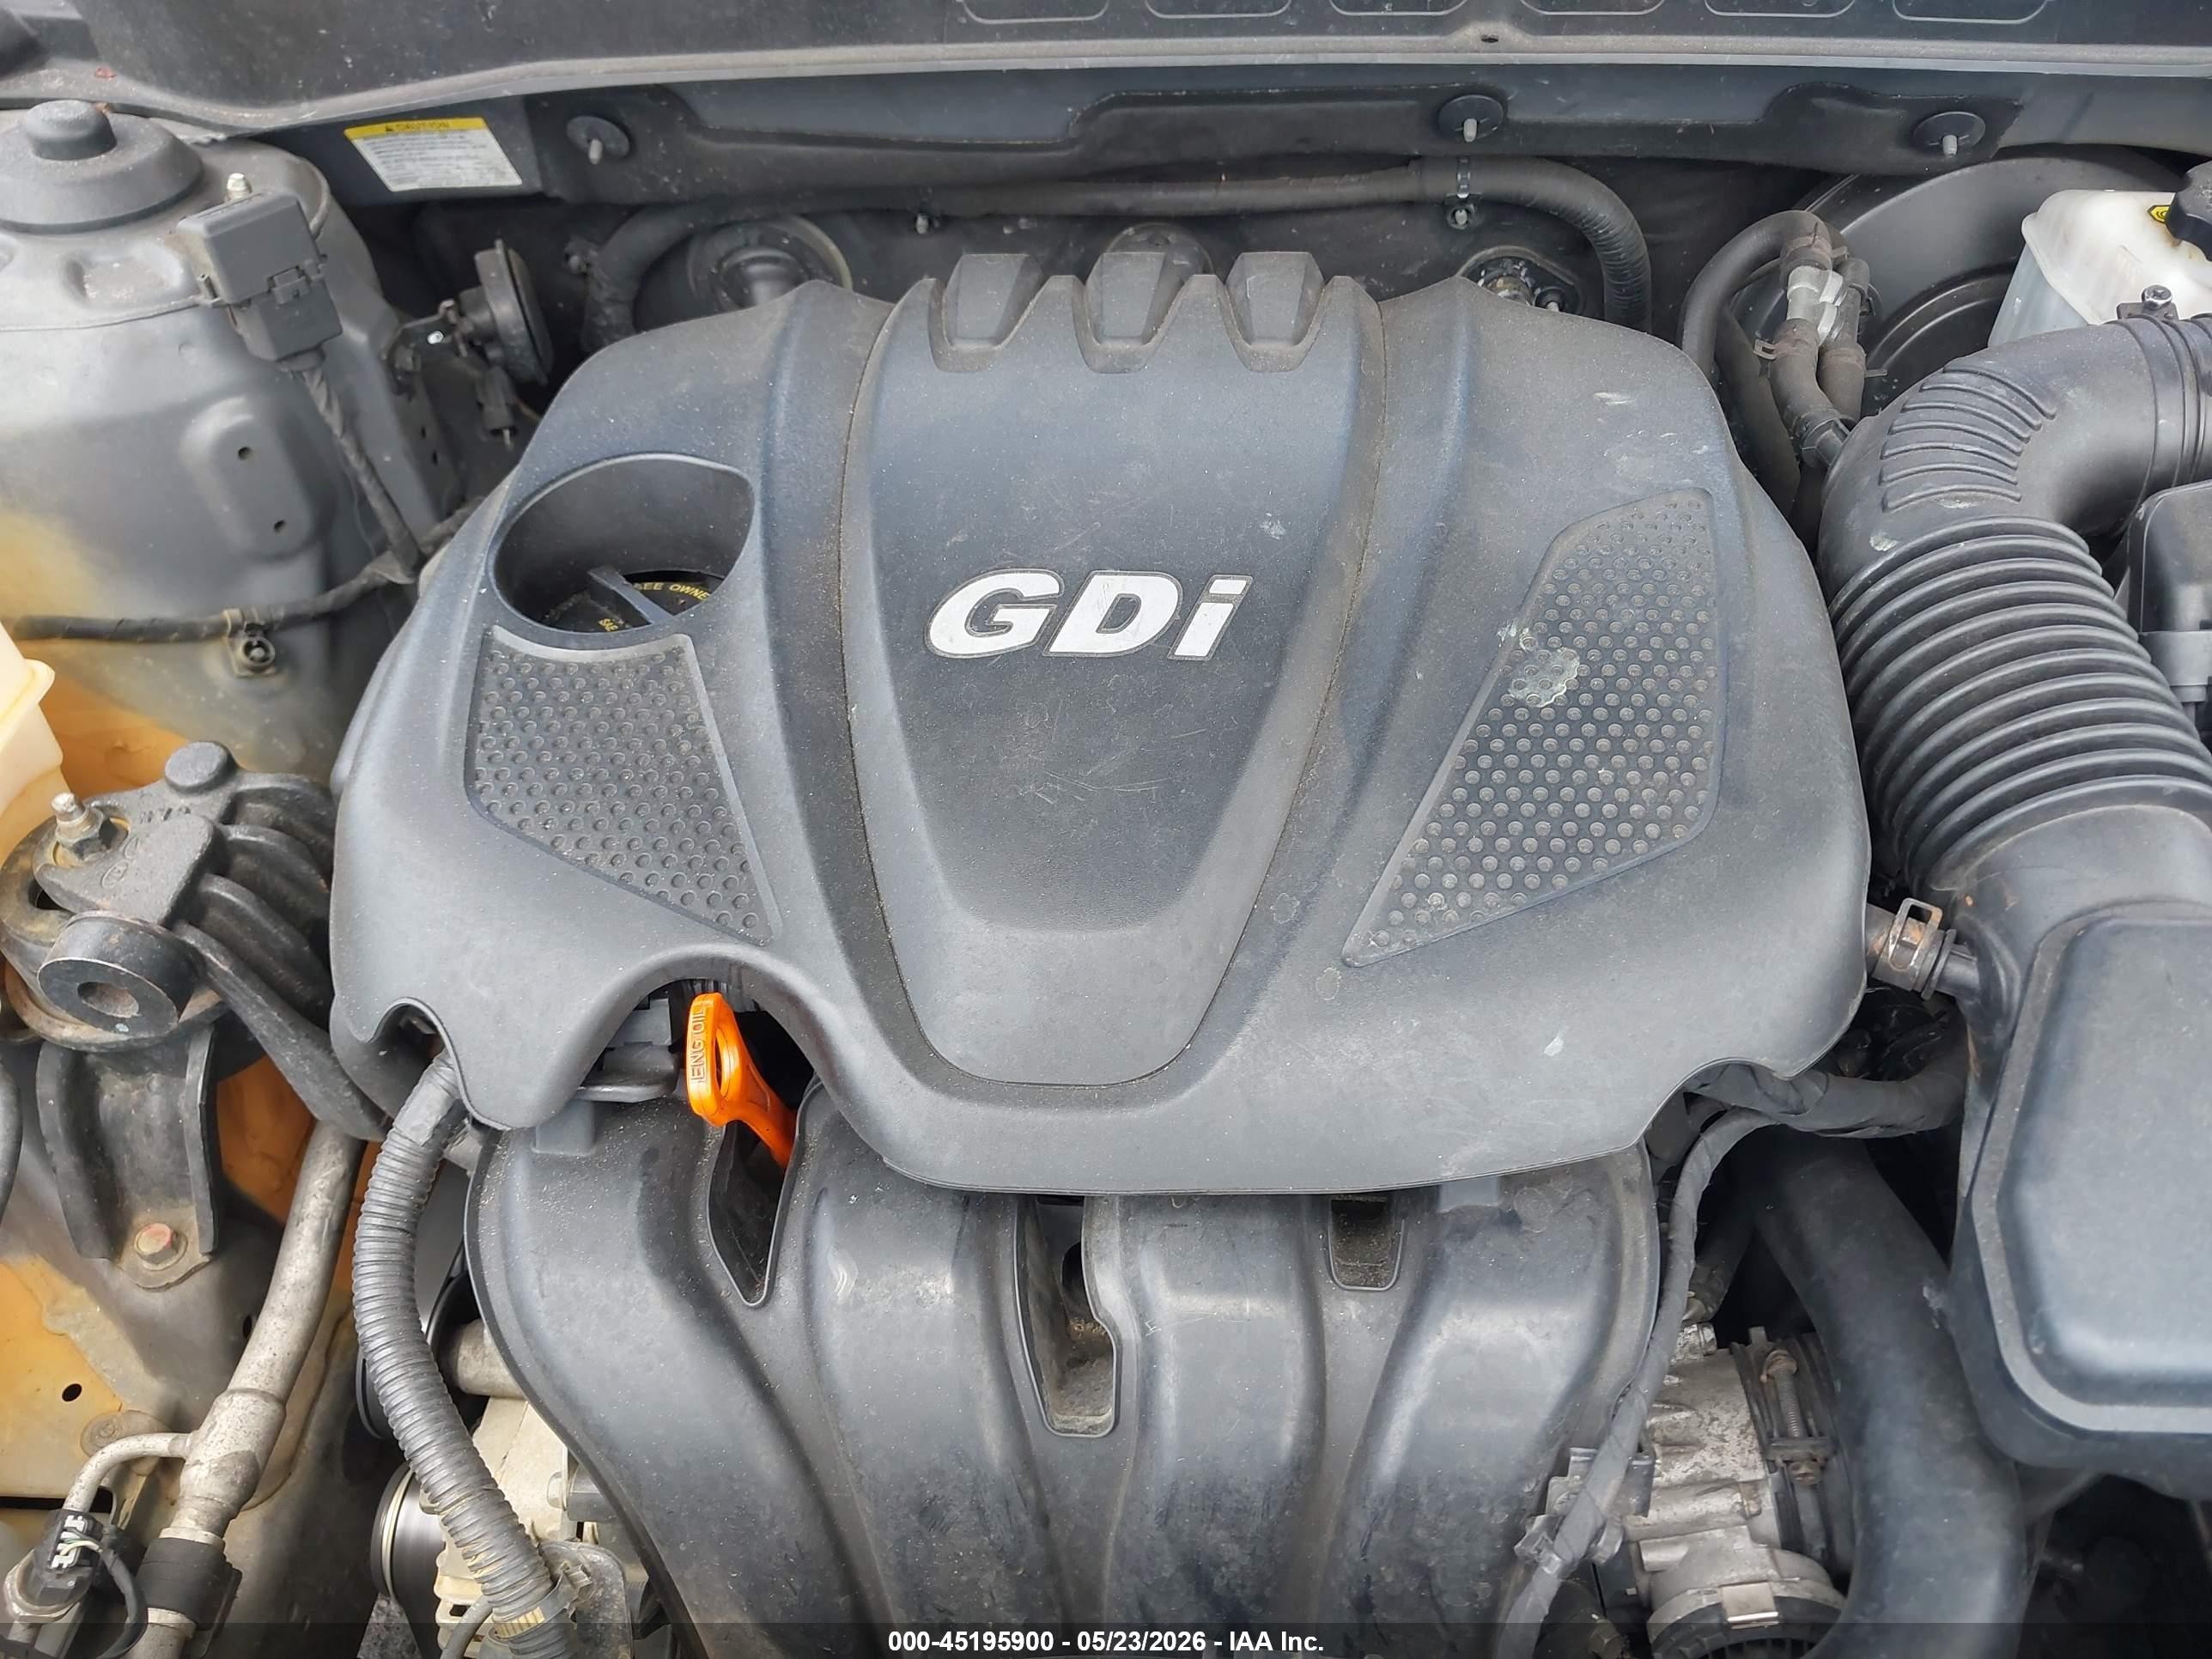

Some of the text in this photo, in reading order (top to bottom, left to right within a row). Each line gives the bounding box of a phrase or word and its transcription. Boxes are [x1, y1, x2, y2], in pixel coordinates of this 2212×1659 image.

[925, 568, 1252, 660] GDi
[690, 1006, 708, 1081] ENG OIL
